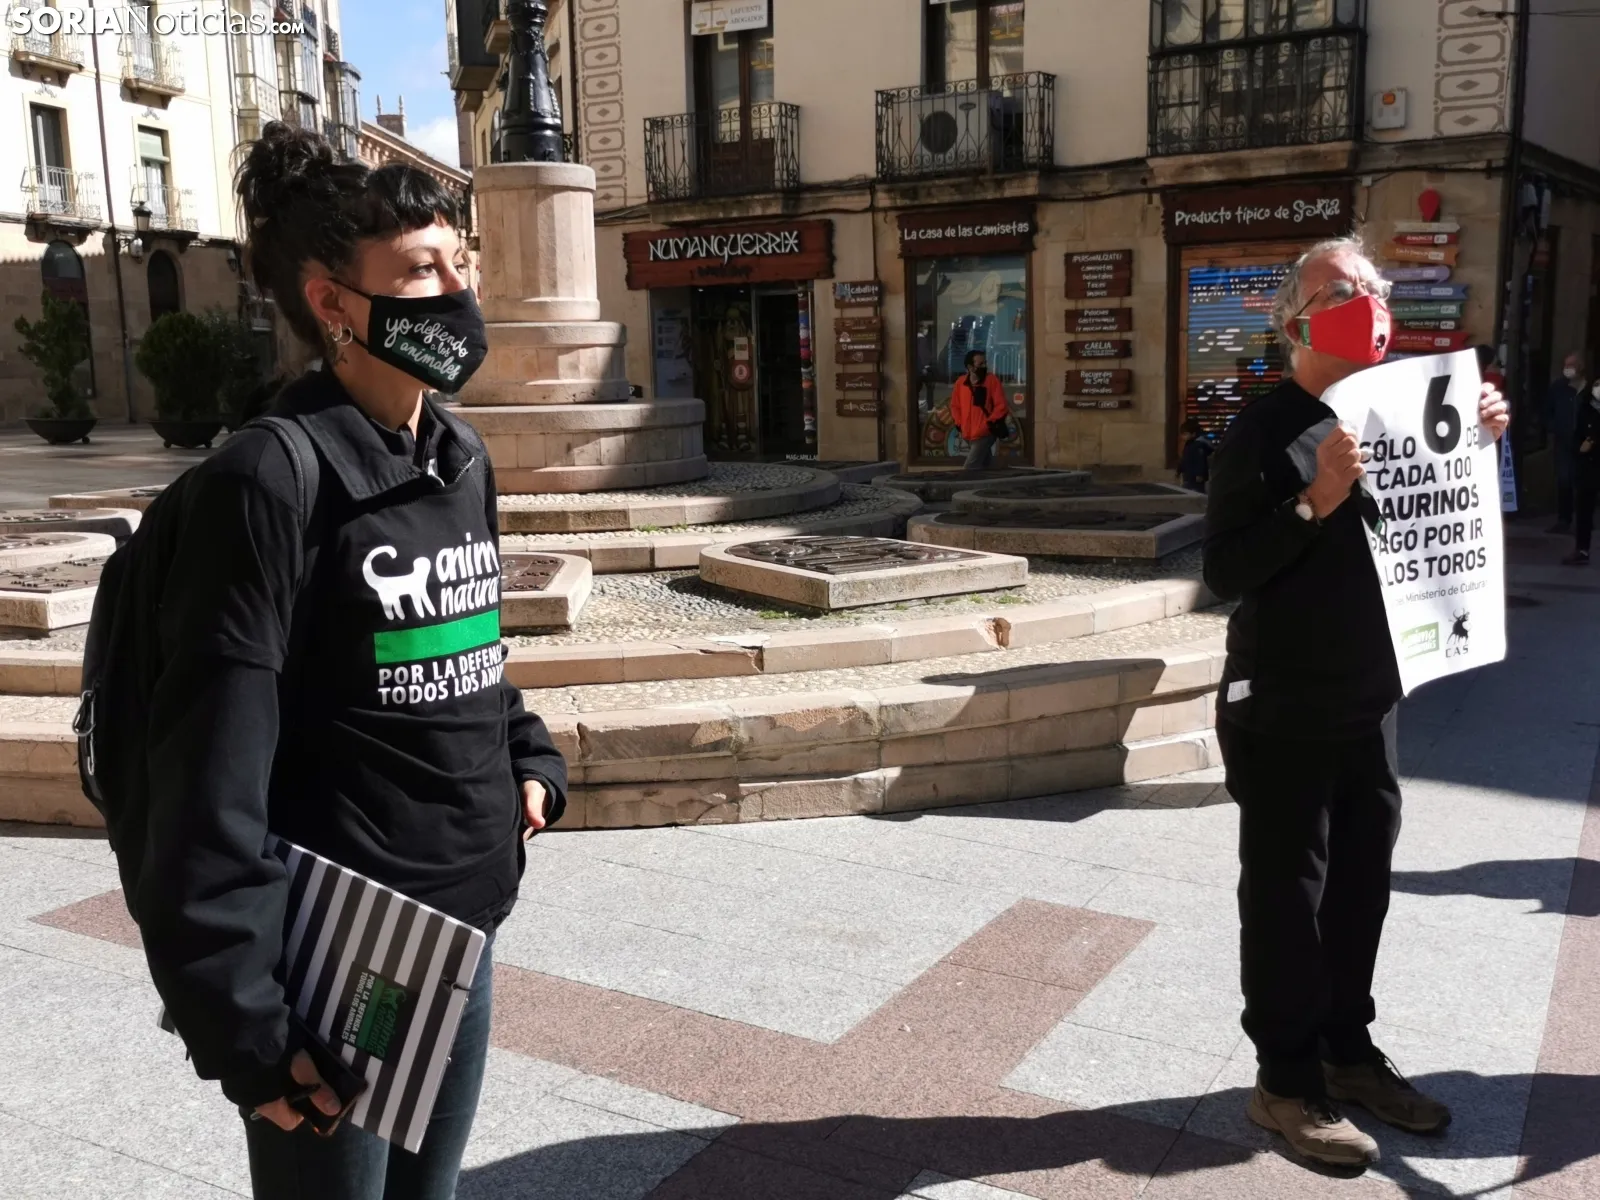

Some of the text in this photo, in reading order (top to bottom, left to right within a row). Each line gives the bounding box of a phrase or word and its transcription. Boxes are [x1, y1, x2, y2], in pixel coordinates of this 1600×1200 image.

[904, 228, 917, 240] La
[944, 226, 956, 238] de
[958, 224, 972, 237] las
[1175, 206, 1232, 226] Producto
[1235, 205, 1270, 224] típico
[1274, 206, 1289, 220] de
[648, 230, 799, 266] NUMANGUERRIX
[384, 318, 468, 358] yo defiendo
[438, 342, 451, 357] los
[400, 342, 460, 380] animales
[1423, 374, 1462, 454] 6
[1376, 456, 1472, 490] CADA 100
[1377, 484, 1479, 522] AURINOS
[1424, 522, 1464, 549] POR
[1470, 518, 1483, 540] IR
[1385, 559, 1419, 586] LOS
[1424, 547, 1486, 578] TOROS
[1406, 588, 1446, 602] Ministerio
[1448, 586, 1458, 596] de
[1446, 645, 1468, 658] CAS
[378, 664, 424, 686] POR
[432, 658, 455, 681] LA
[378, 682, 448, 706] TODOS
[454, 672, 478, 697] LOS
[342, 972, 368, 1040] TODOS LOS ANIMALES
[349, 974, 376, 1044] POR LA DEFENSA DE
